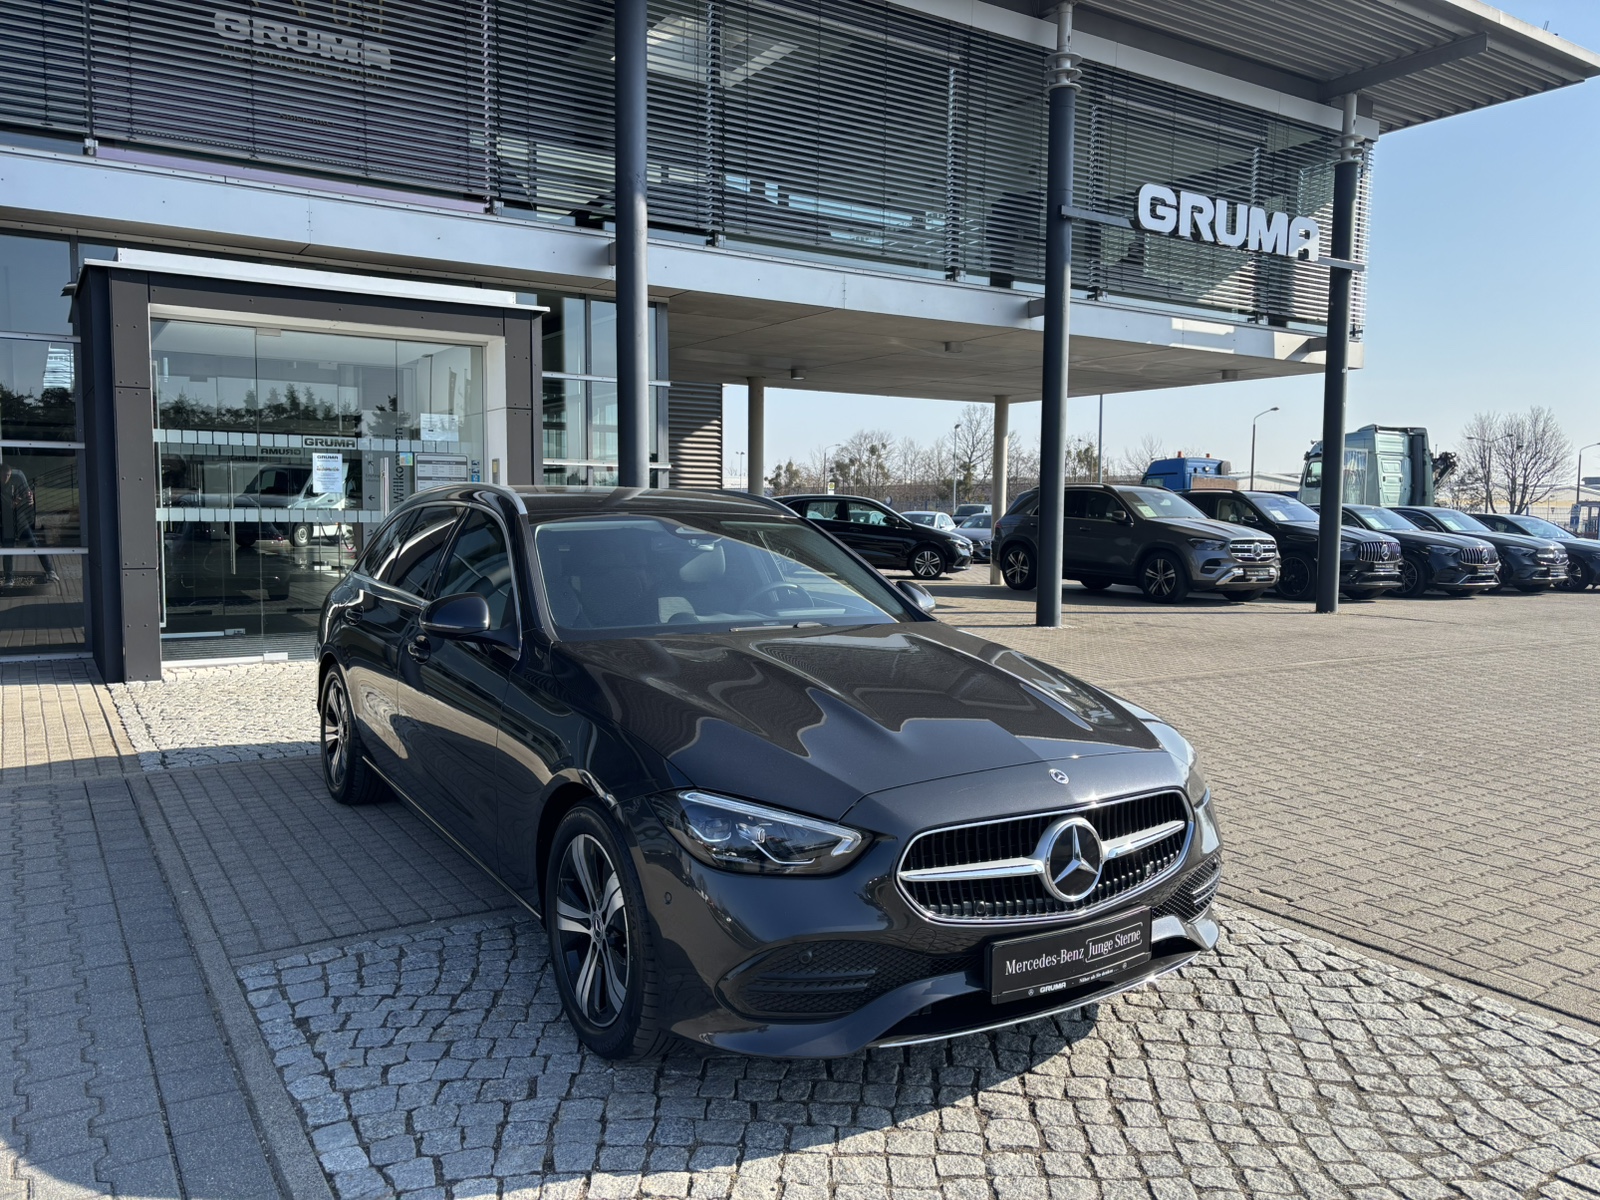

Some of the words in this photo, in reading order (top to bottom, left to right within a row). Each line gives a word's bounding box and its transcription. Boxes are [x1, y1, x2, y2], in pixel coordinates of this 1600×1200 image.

[214, 12, 391, 70] GRUMA
[1136, 183, 1320, 262] GRUMA
[304, 438, 355, 448] GRUMA
[1005, 948, 1084, 976] Mercedes-Benz
[1088, 939, 1113, 959] Junge
[1114, 929, 1141, 948] Sterne
[1039, 982, 1066, 993] GRUMA
